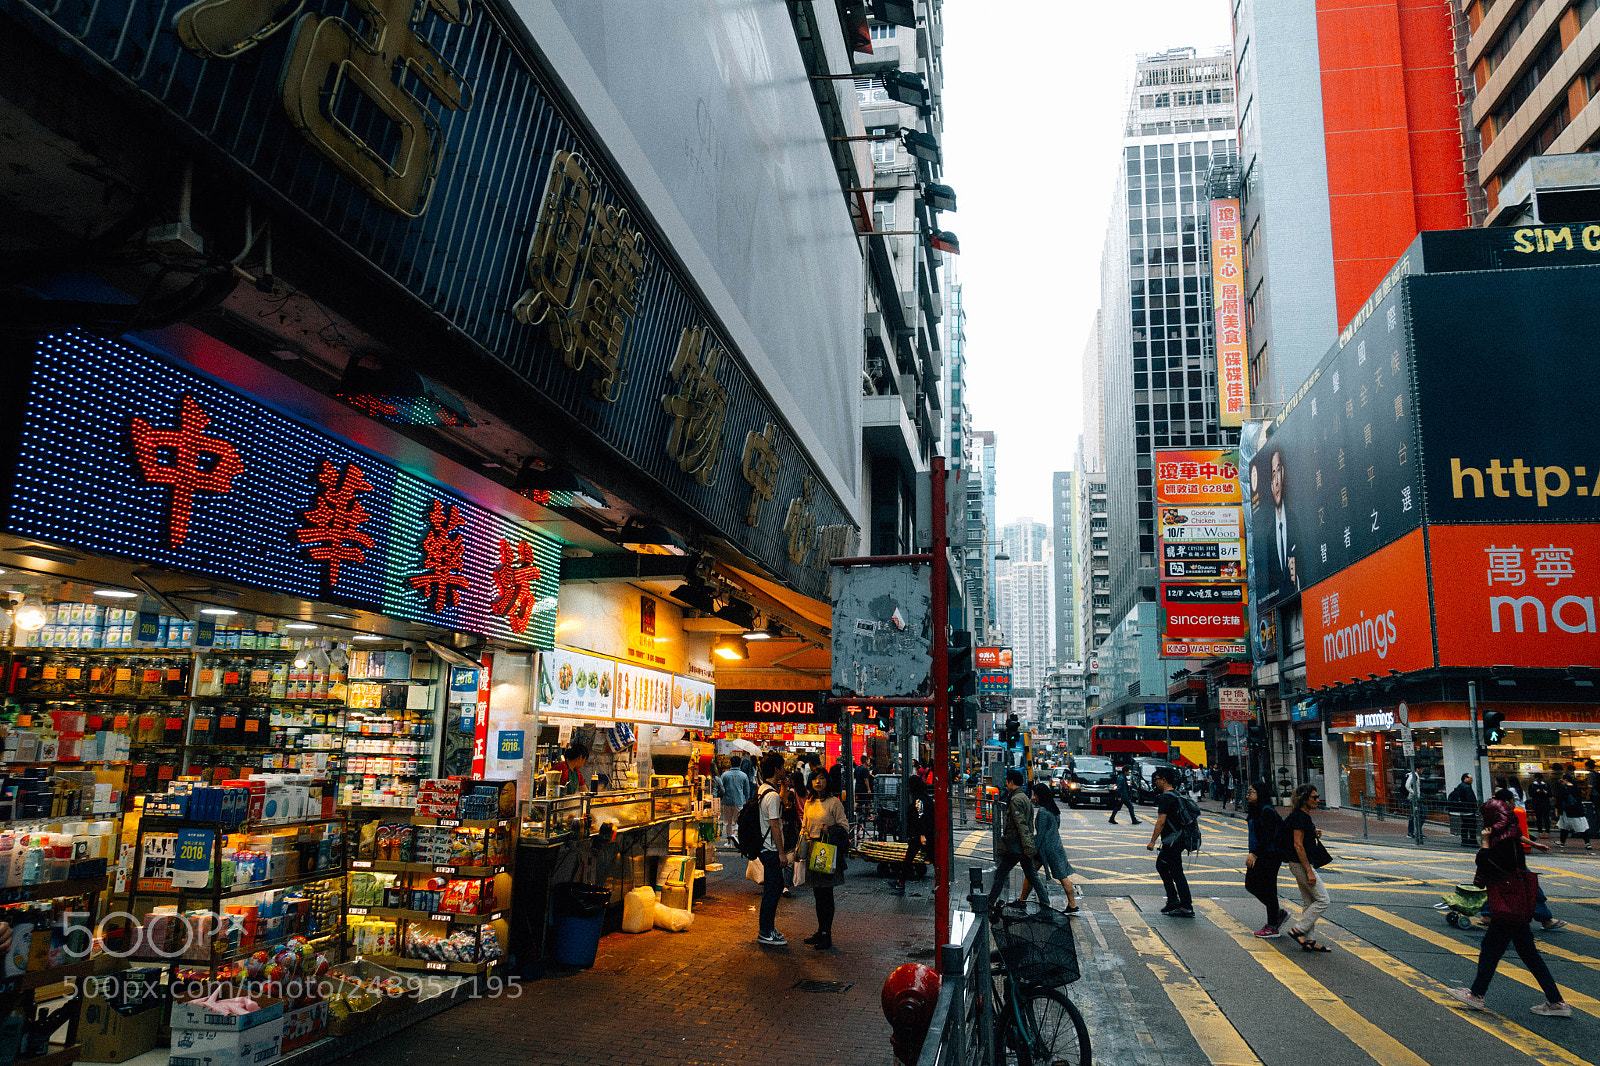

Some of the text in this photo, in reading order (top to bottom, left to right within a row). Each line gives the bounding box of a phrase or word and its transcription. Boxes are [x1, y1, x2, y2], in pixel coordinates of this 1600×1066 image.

[1514, 227, 1574, 253] SIM
[1167, 528, 1185, 538] 10/F
[1220, 548, 1238, 556] 8/F
[1484, 543, 1576, 586] 萬寧
[1321, 591, 1340, 628] 萬寧
[1489, 595, 1600, 634] ma
[1170, 615, 1221, 625] sincere
[1323, 609, 1397, 663] mannings
[1167, 645, 1246, 653] KING WAH CENTRE
[754, 701, 814, 715] BONJOUR
[1365, 709, 1395, 729] mannings
